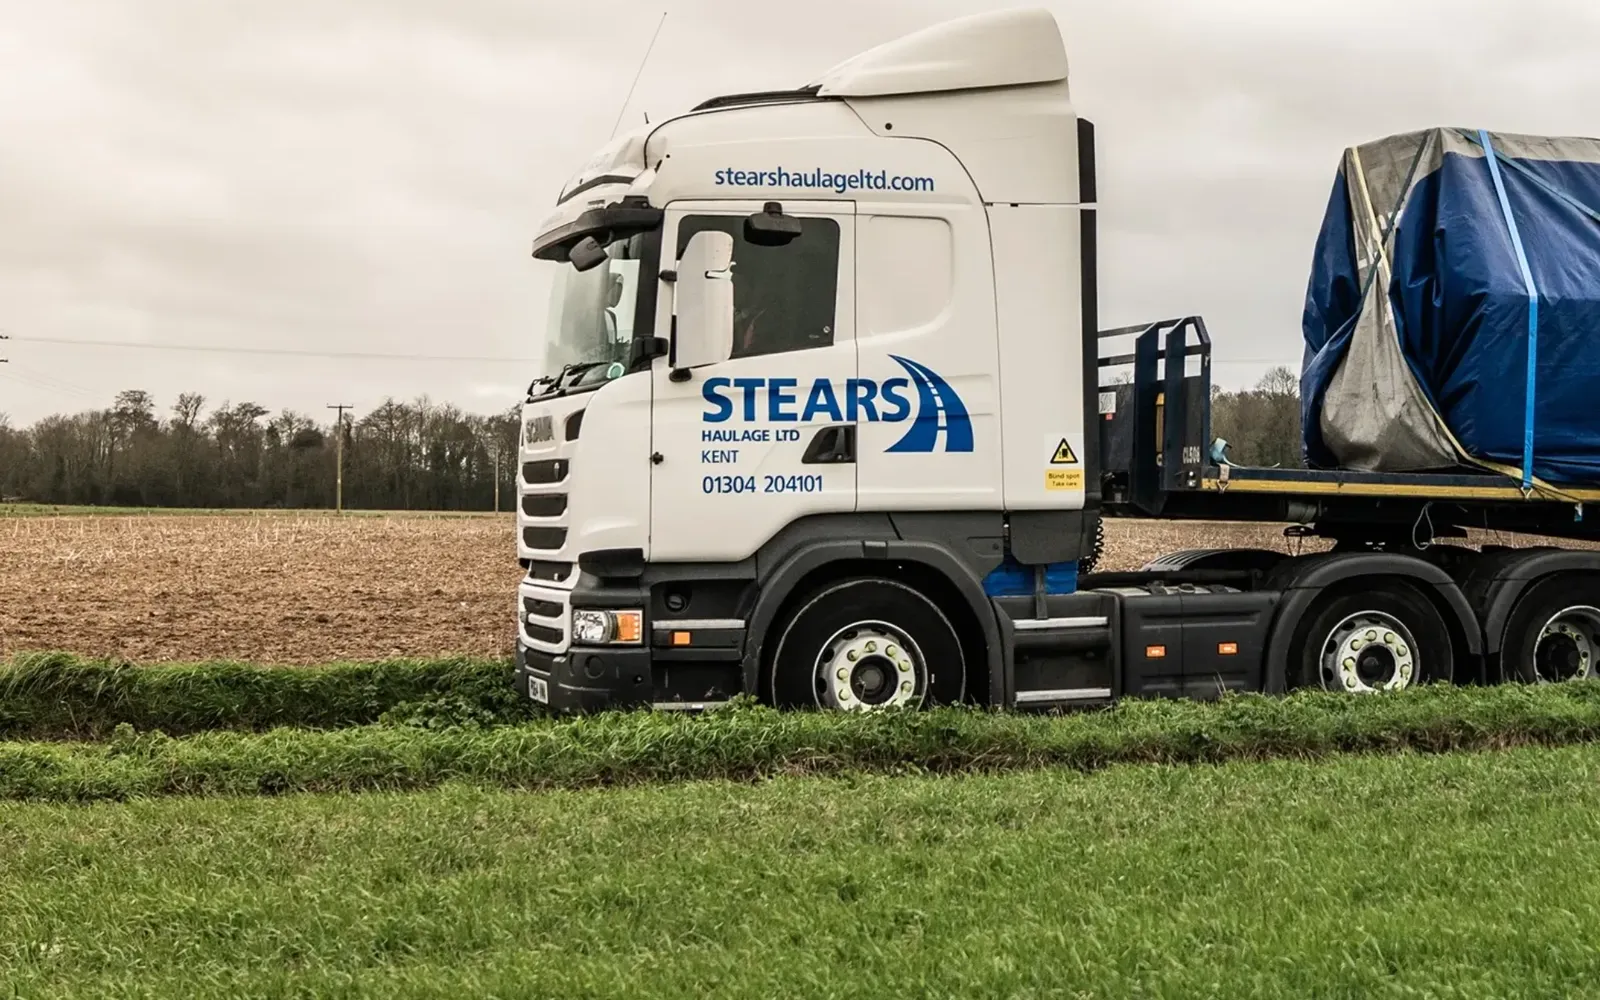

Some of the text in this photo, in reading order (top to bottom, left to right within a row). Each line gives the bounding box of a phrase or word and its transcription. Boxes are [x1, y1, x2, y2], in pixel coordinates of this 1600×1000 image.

[715, 166, 935, 194] stearshaulageltd.com
[702, 377, 911, 422] STEARS
[701, 429, 800, 442] HAULAGE LTD
[701, 450, 739, 463] KENT
[702, 475, 823, 493] 01304 204101
